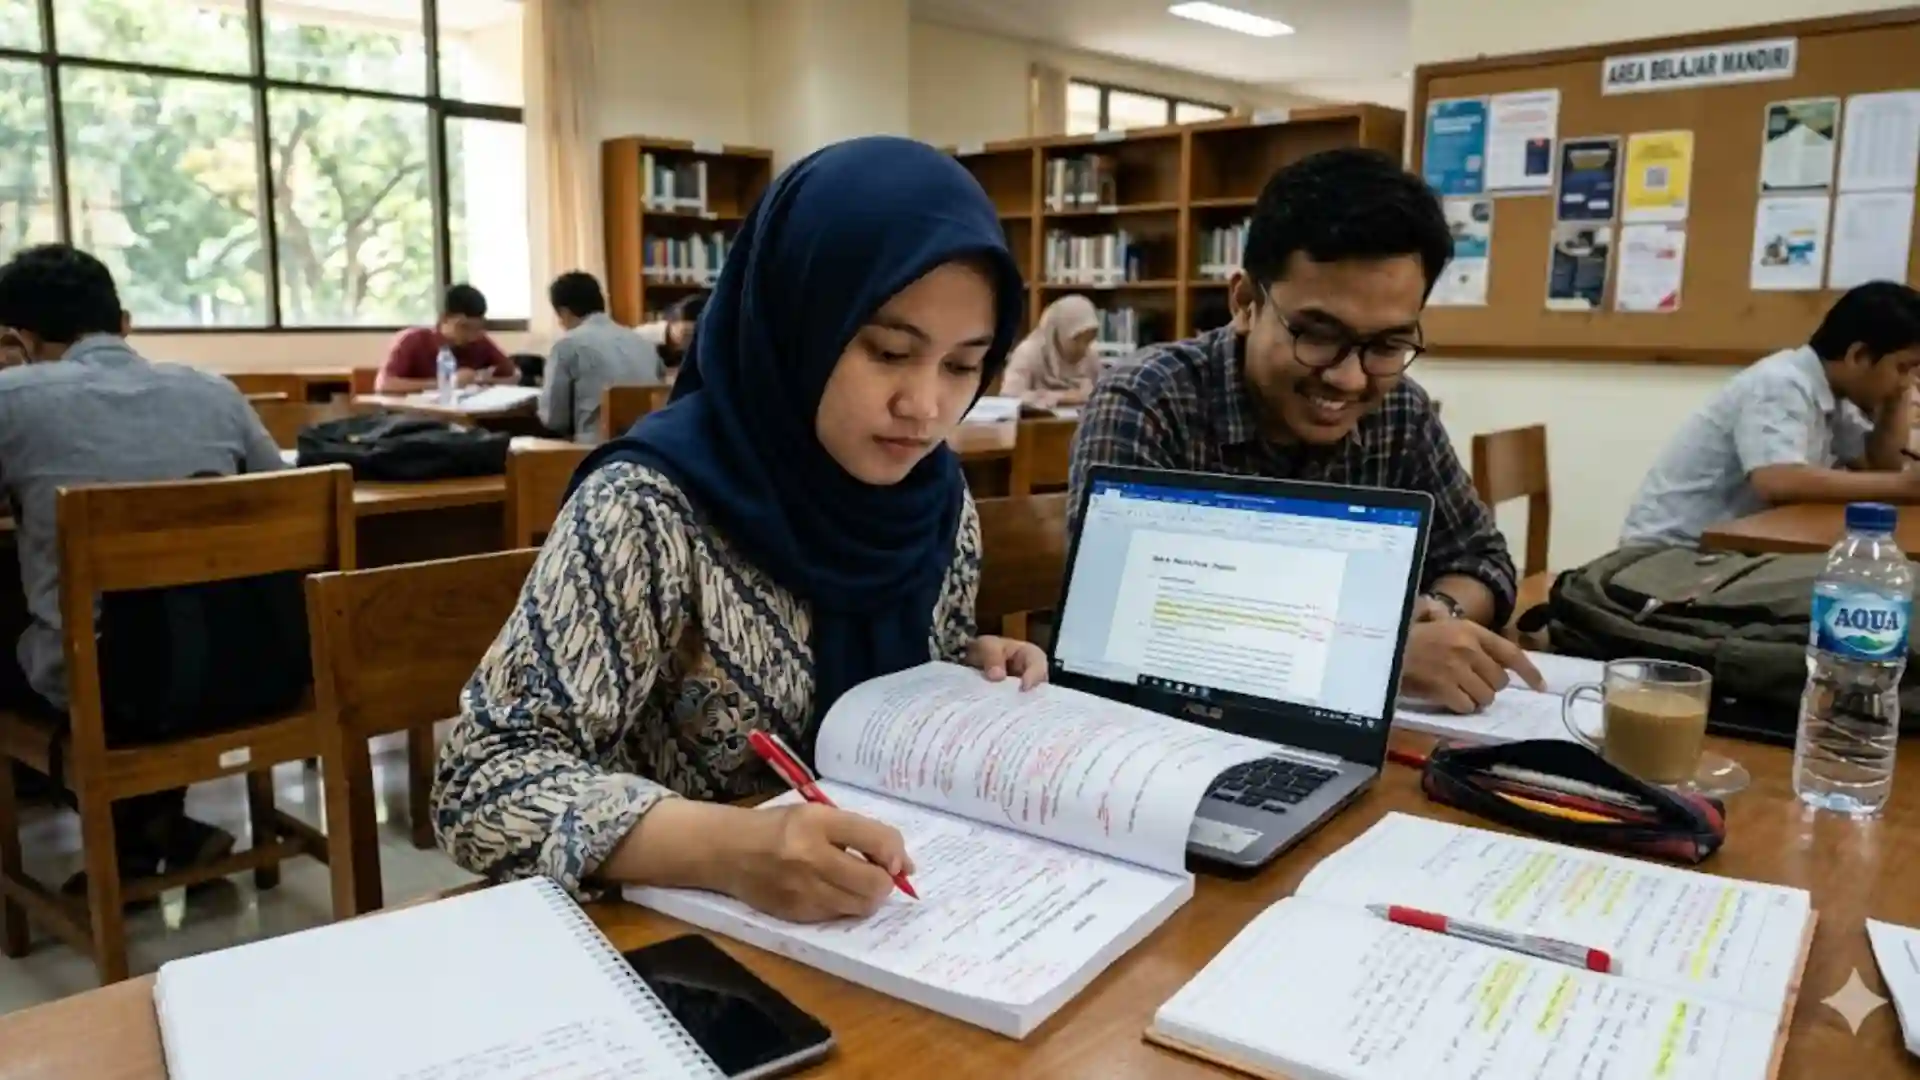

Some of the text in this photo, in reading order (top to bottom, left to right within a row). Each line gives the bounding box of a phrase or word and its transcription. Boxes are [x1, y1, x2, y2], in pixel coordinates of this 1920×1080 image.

[1608, 47, 1790, 82] AREA BELAJAR MANDIRI
[1834, 607, 1900, 634] AQUA
